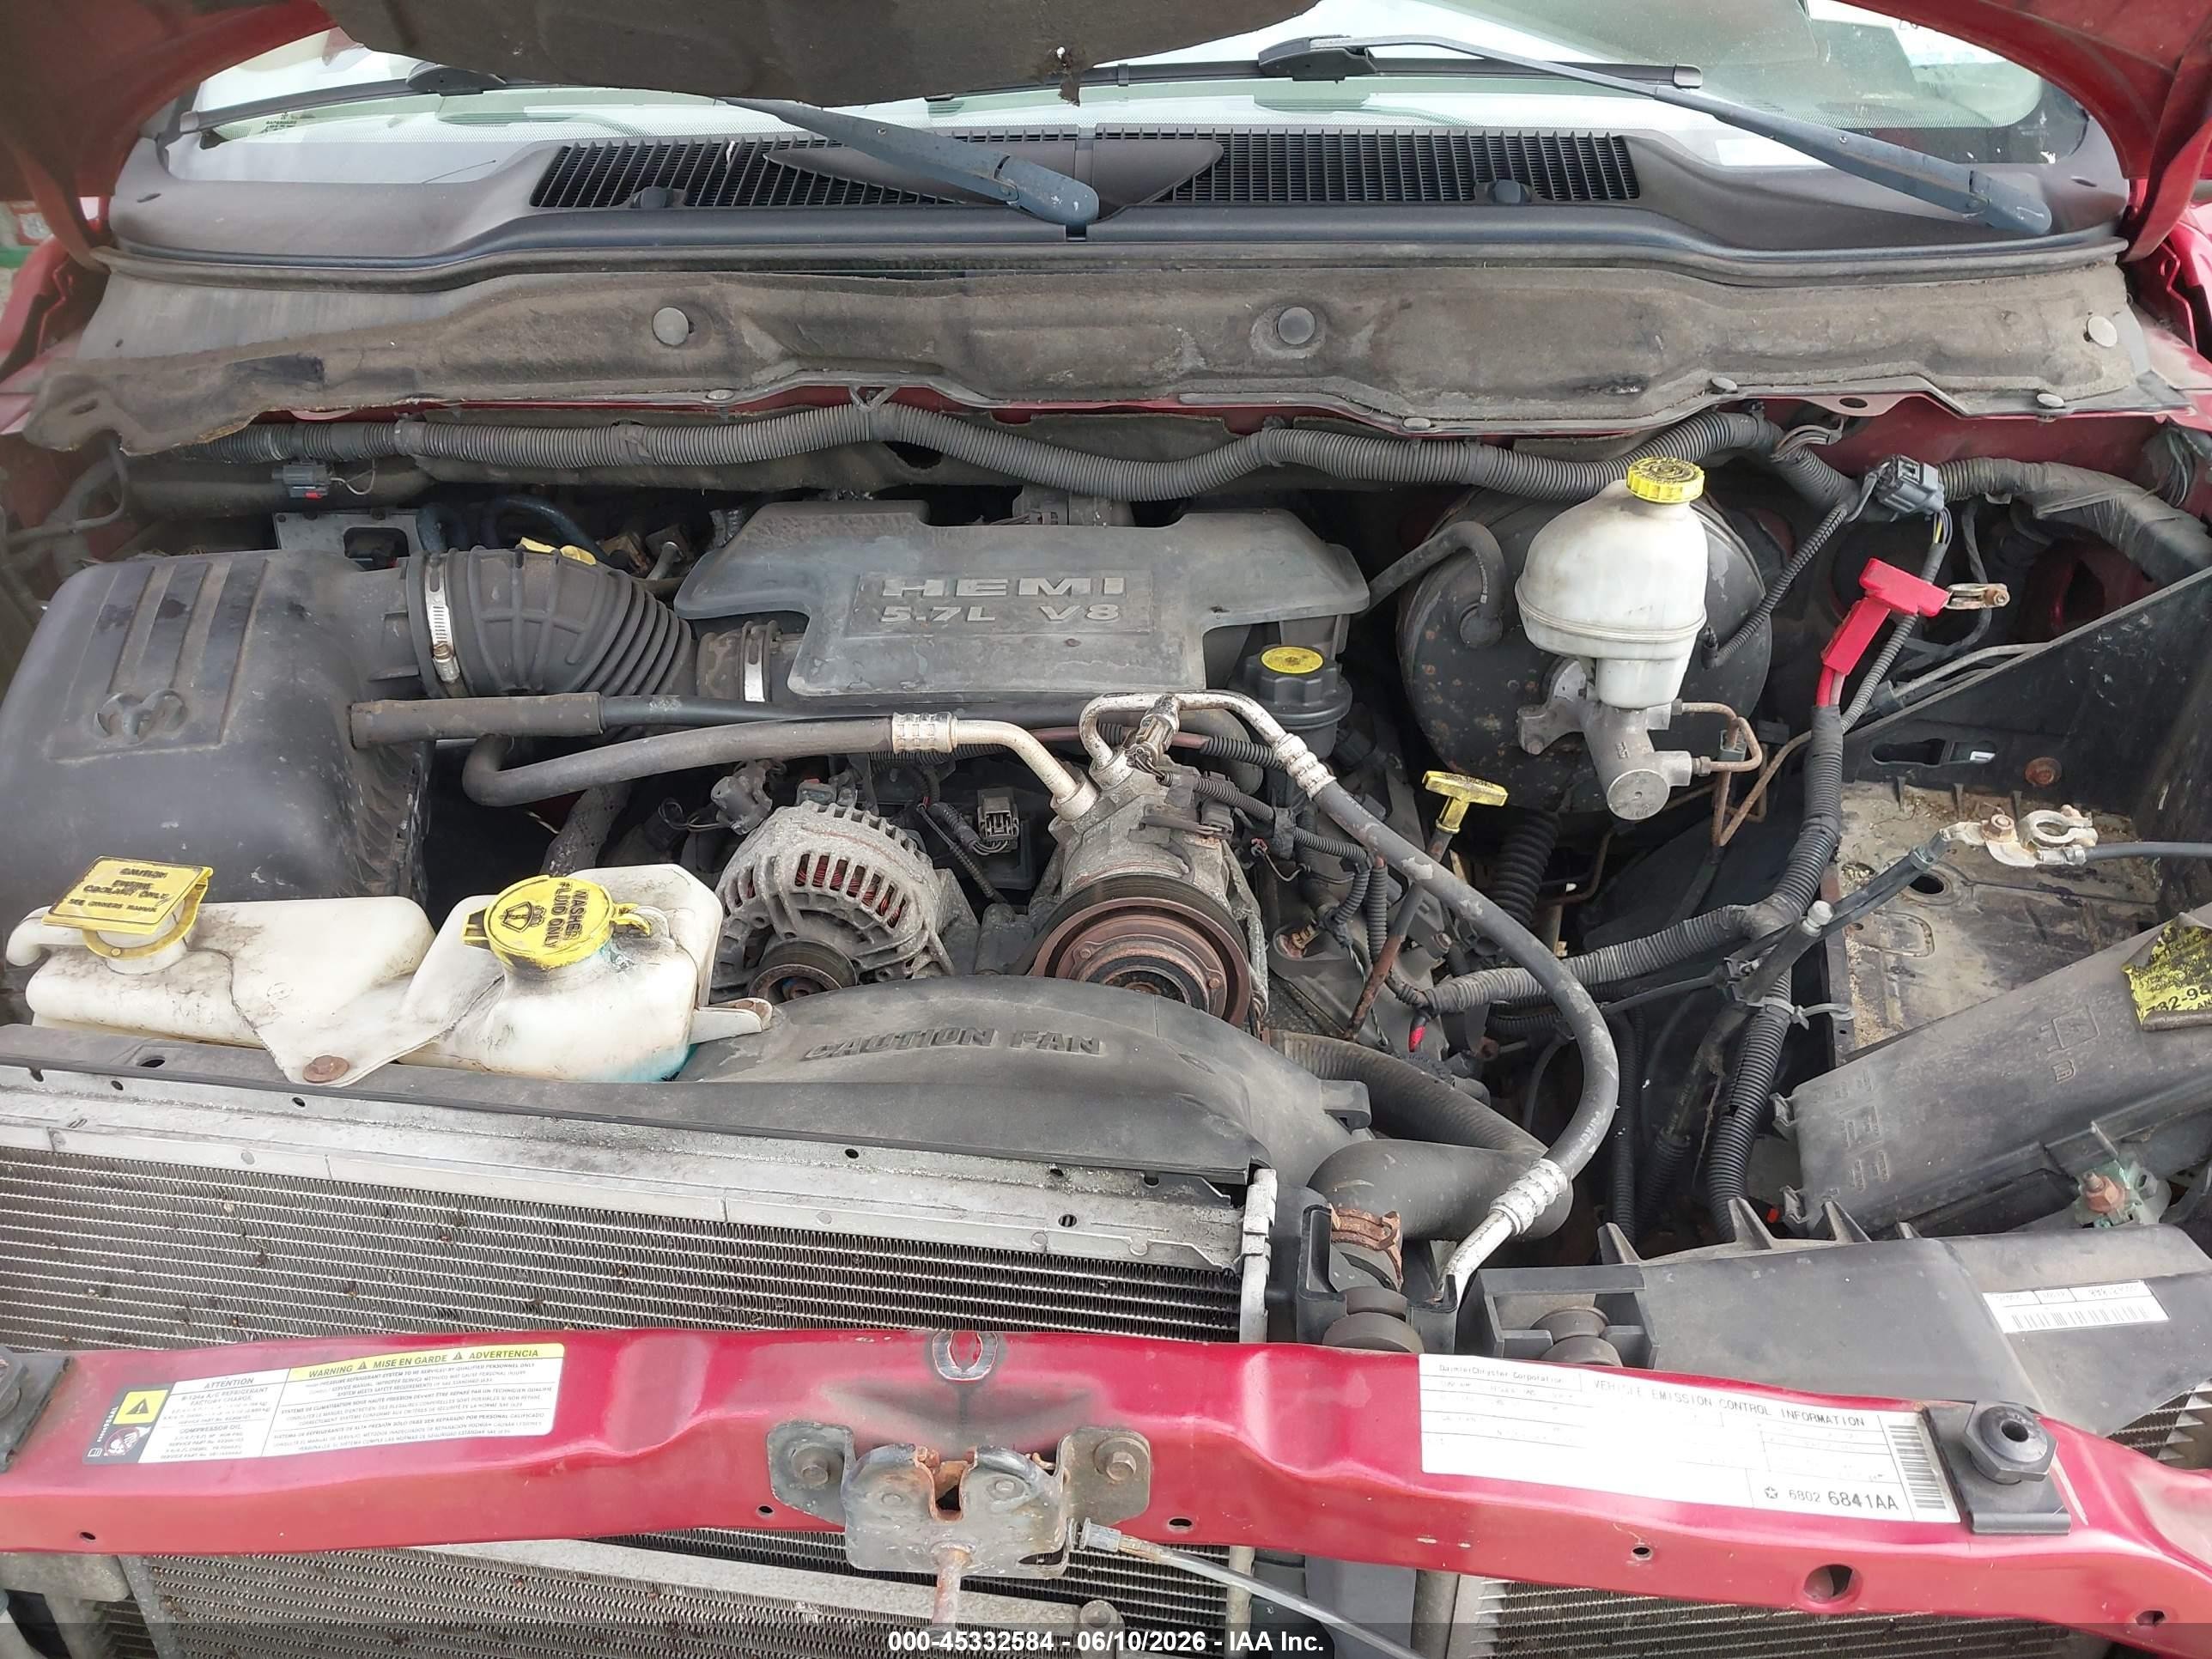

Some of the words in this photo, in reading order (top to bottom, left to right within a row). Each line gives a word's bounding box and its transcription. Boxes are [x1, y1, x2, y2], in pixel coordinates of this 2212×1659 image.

[882, 578, 1126, 597] HEMI
[880, 605, 996, 623] 5.7L
[1039, 604, 1119, 622] V8
[551, 882, 570, 915] FLUID
[566, 889, 588, 939] WASHER
[544, 918, 566, 948] ONLY
[799, 1027, 997, 1061] CAUTION
[1010, 1030, 1106, 1057] FAN
[308, 1365, 353, 1378] WARNING
[373, 1358, 396, 1369] MISE
[399, 1357, 412, 1366] EN
[414, 1355, 447, 1364] GARDE
[469, 1350, 538, 1359] ADVERTENCIA
[204, 1377, 254, 1389] ATTENTION
[1651, 1389, 1712, 1407] EMISSION
[1719, 1398, 1772, 1417] CONTROL
[1780, 1408, 1865, 1427] INFORMATION
[1789, 1489, 1820, 1504] 6802
[1827, 1491, 1899, 1510] 6841AA
